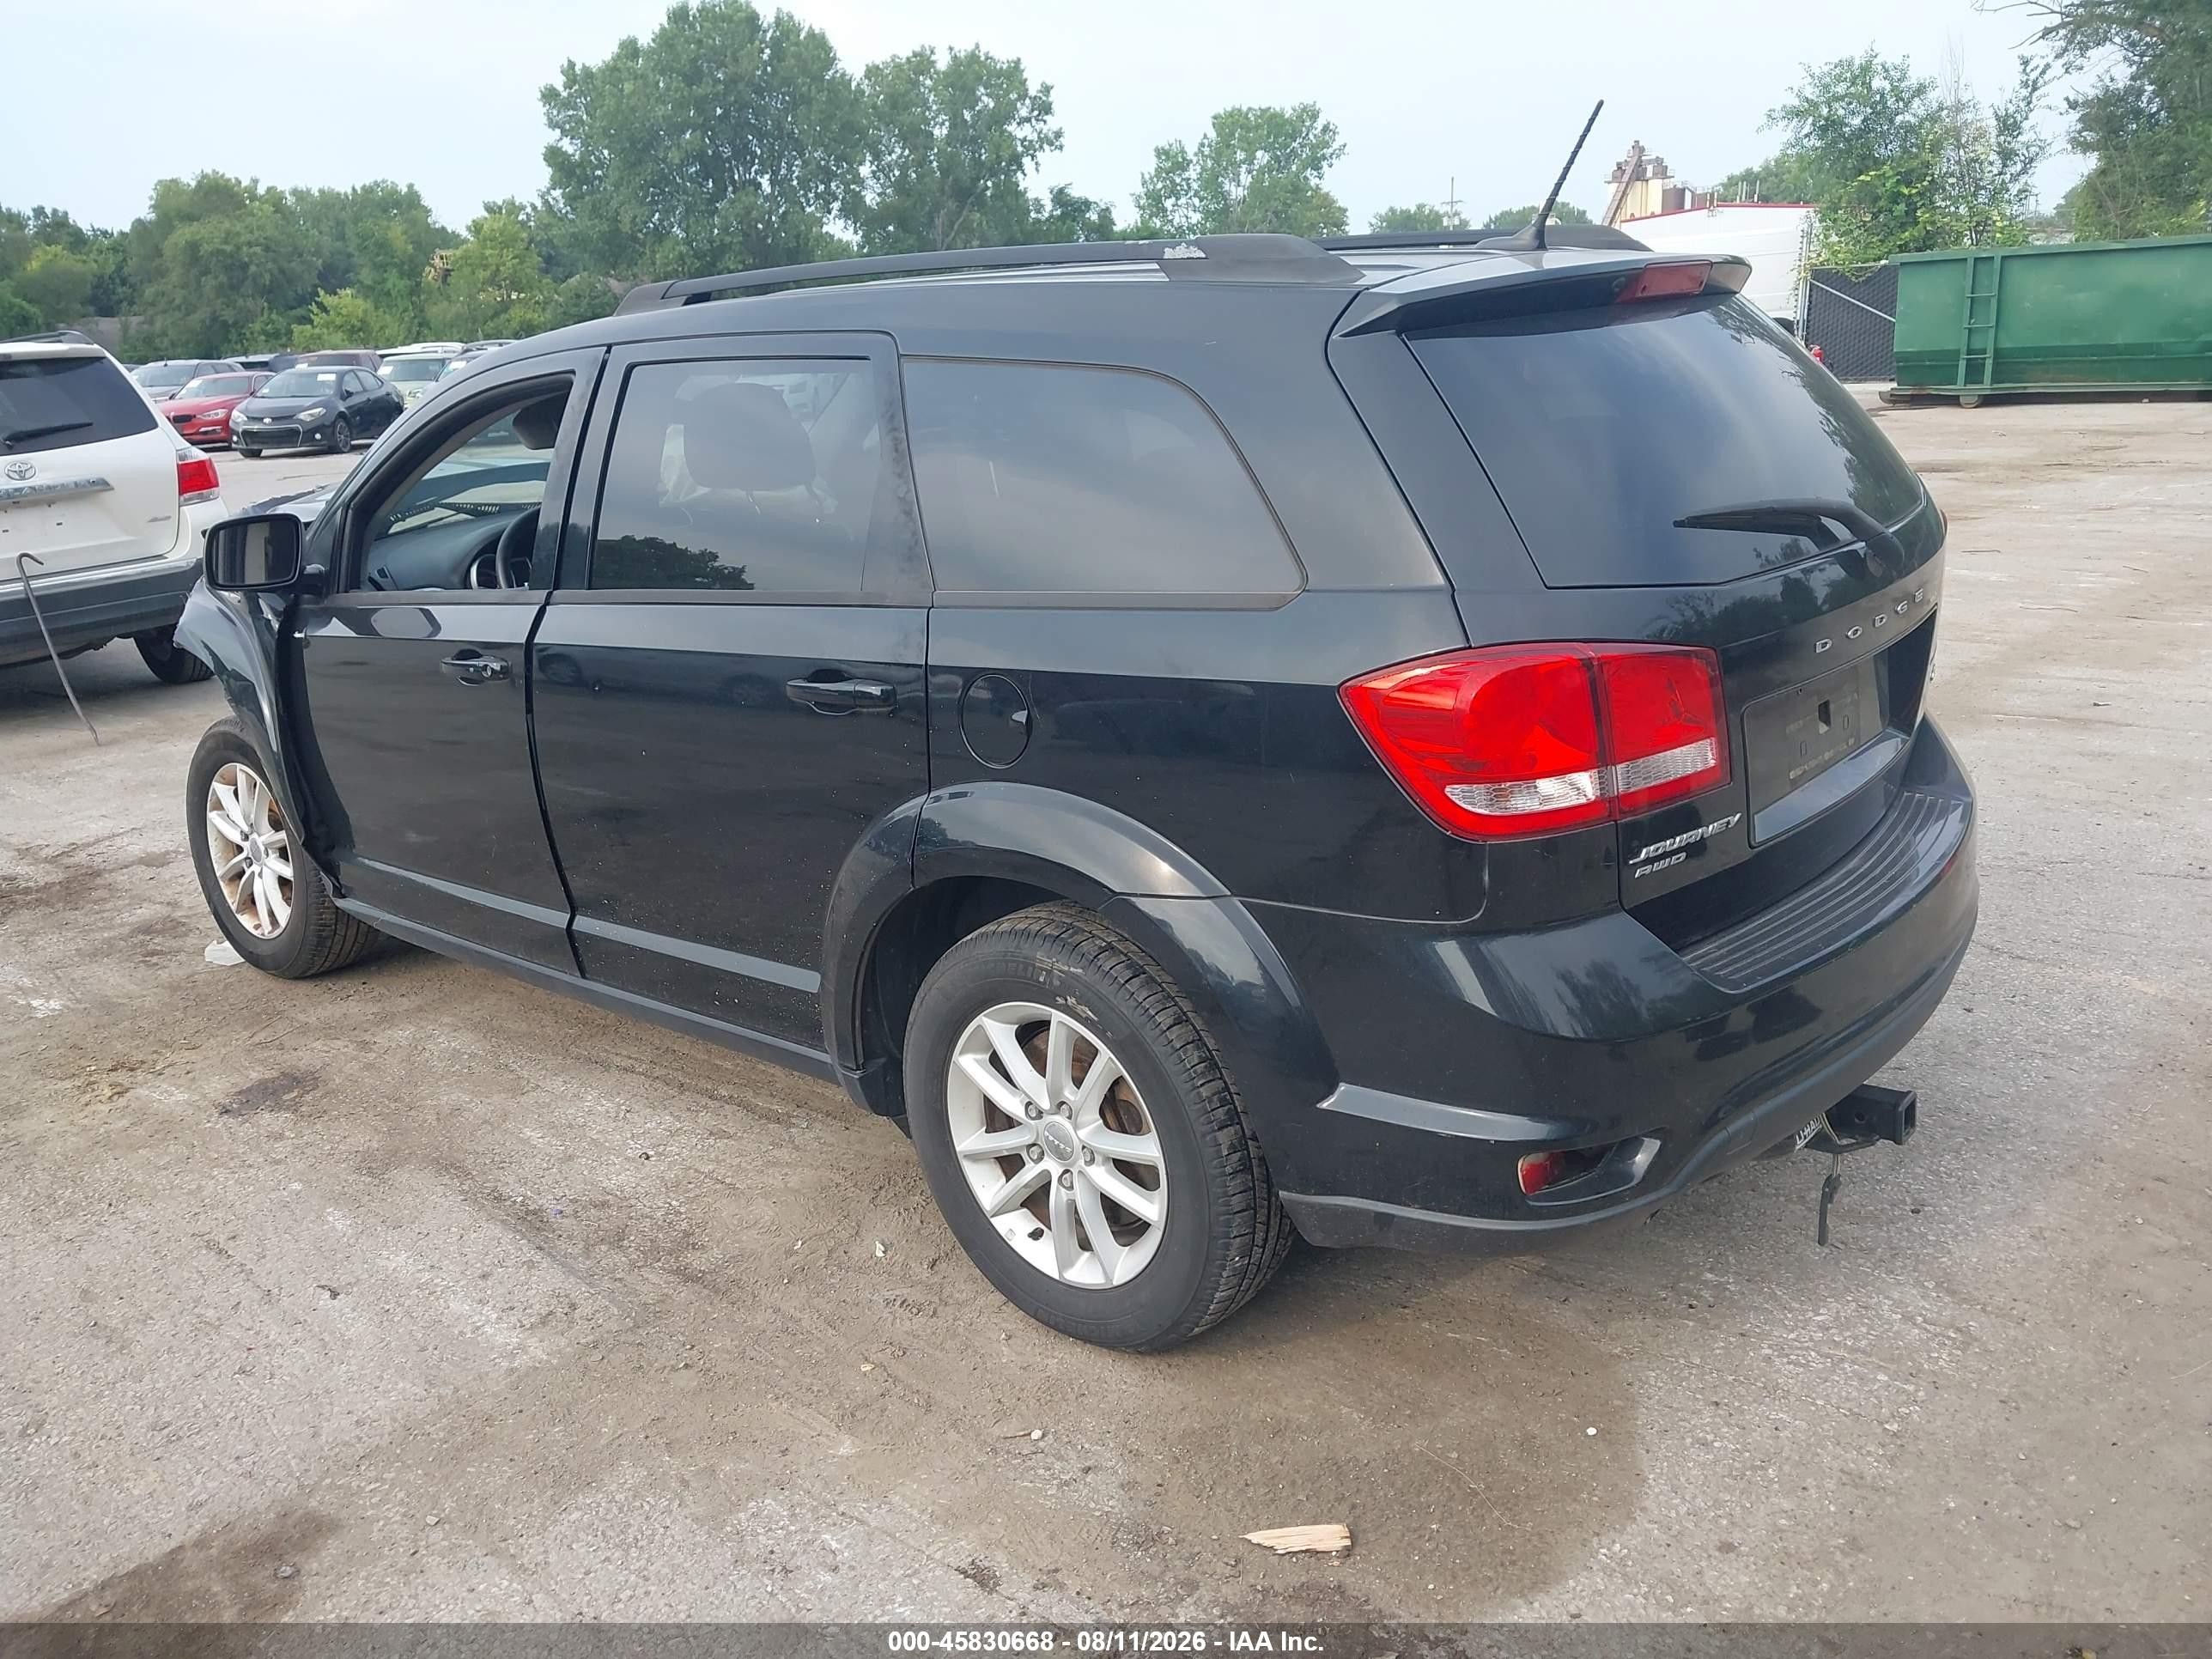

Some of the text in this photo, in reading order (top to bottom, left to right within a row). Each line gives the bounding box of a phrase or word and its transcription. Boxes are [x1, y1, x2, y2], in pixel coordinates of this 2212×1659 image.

[1814, 587, 1923, 653] DODGE
[1629, 812, 1742, 865] JOURNEY
[1634, 852, 1687, 879] AWD
